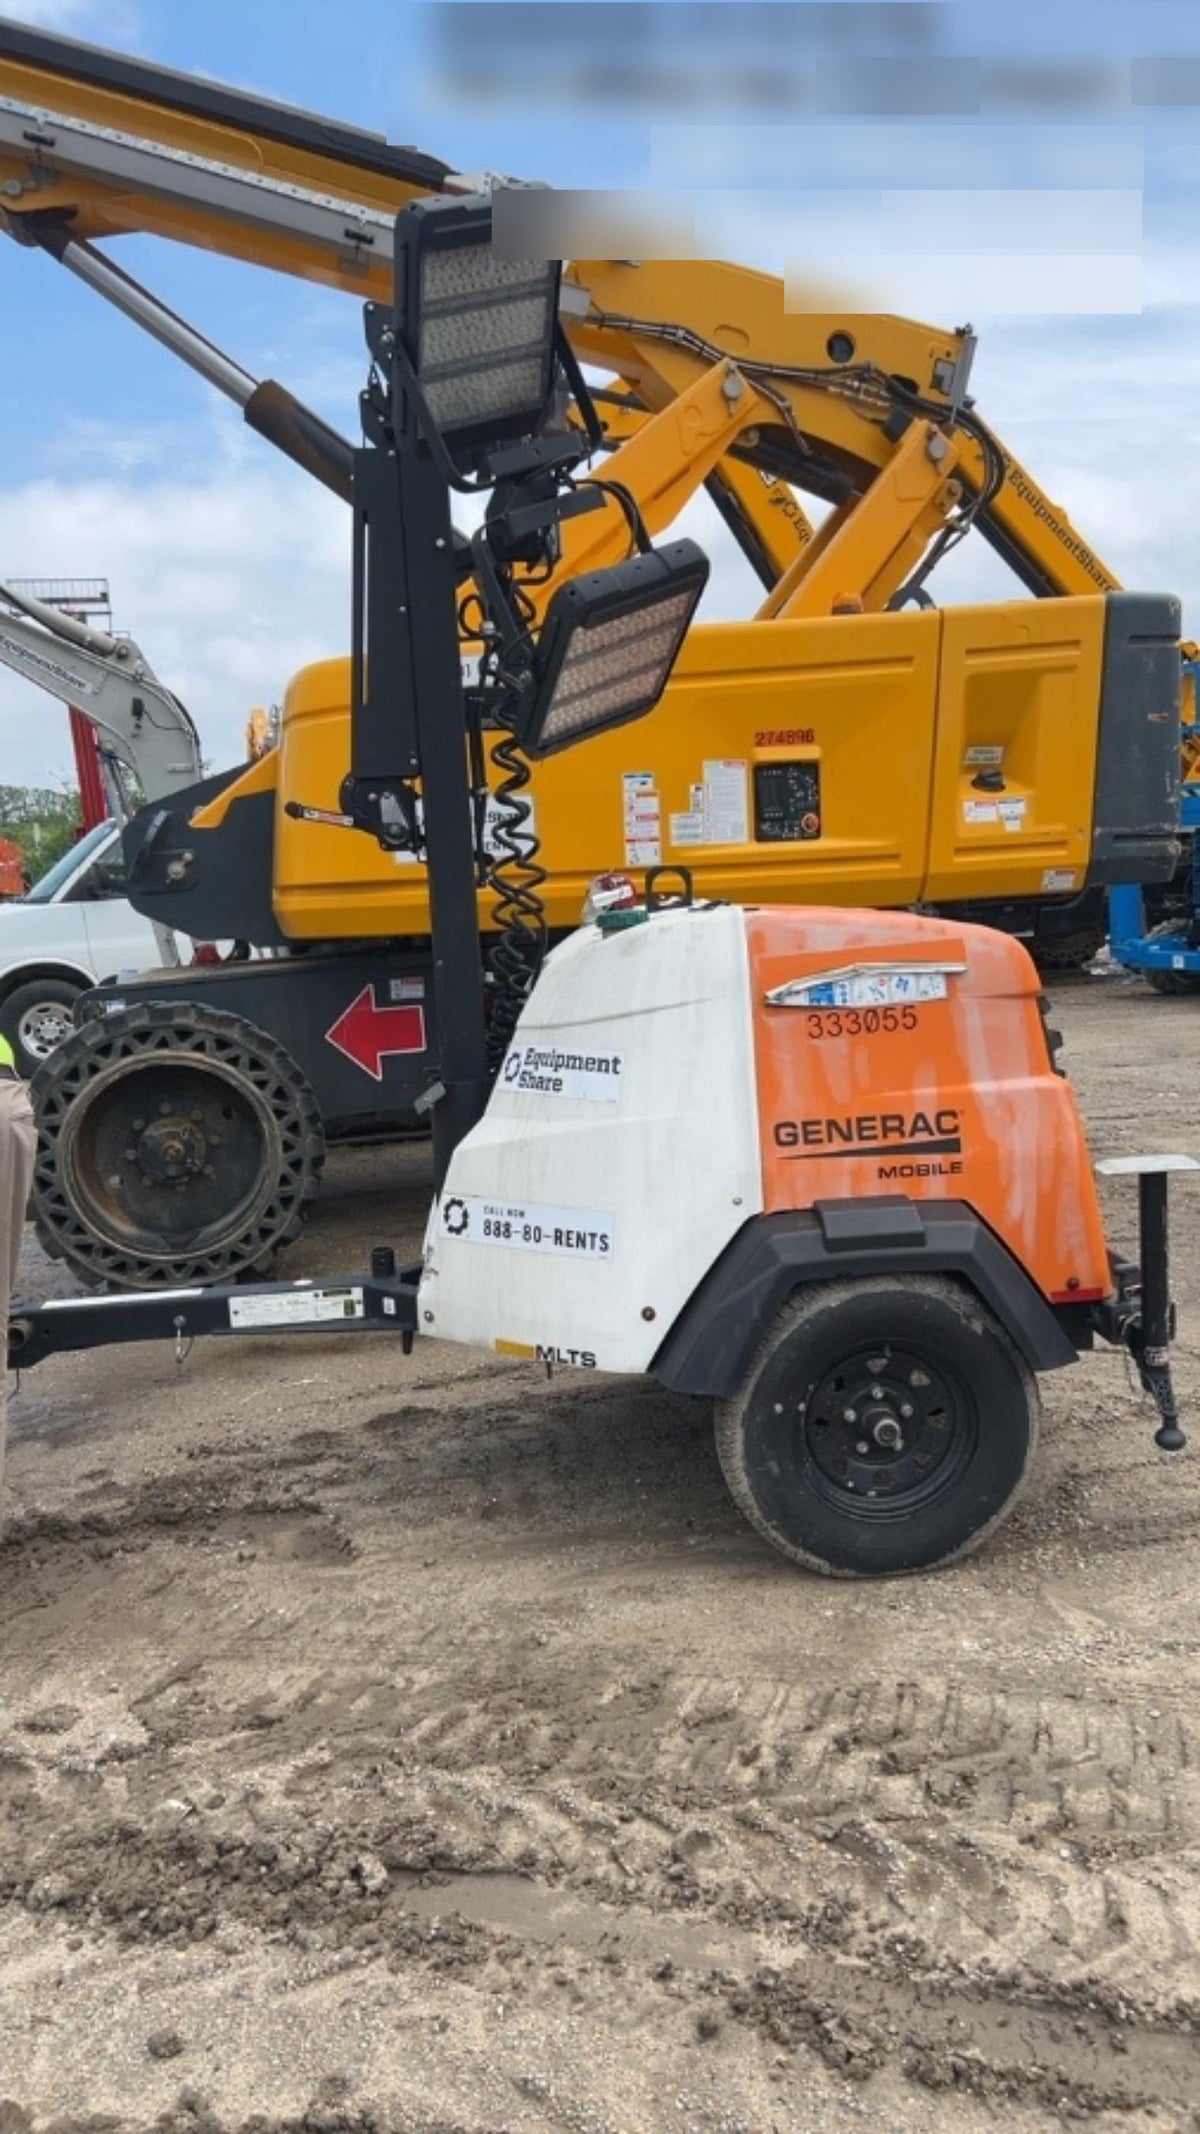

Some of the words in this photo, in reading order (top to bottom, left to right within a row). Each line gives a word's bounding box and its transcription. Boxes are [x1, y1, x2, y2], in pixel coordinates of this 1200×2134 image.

[755, 728, 815, 747] 274896
[807, 1004, 918, 1040] 333055
[523, 1047, 621, 1076] Equipment
[518, 1069, 563, 1092] Share
[773, 1108, 961, 1147] GENERAC
[877, 1160, 963, 1180] MOBILE
[482, 1218, 610, 1253] 888-80-RENTS
[534, 1344, 597, 1369] MLTS
